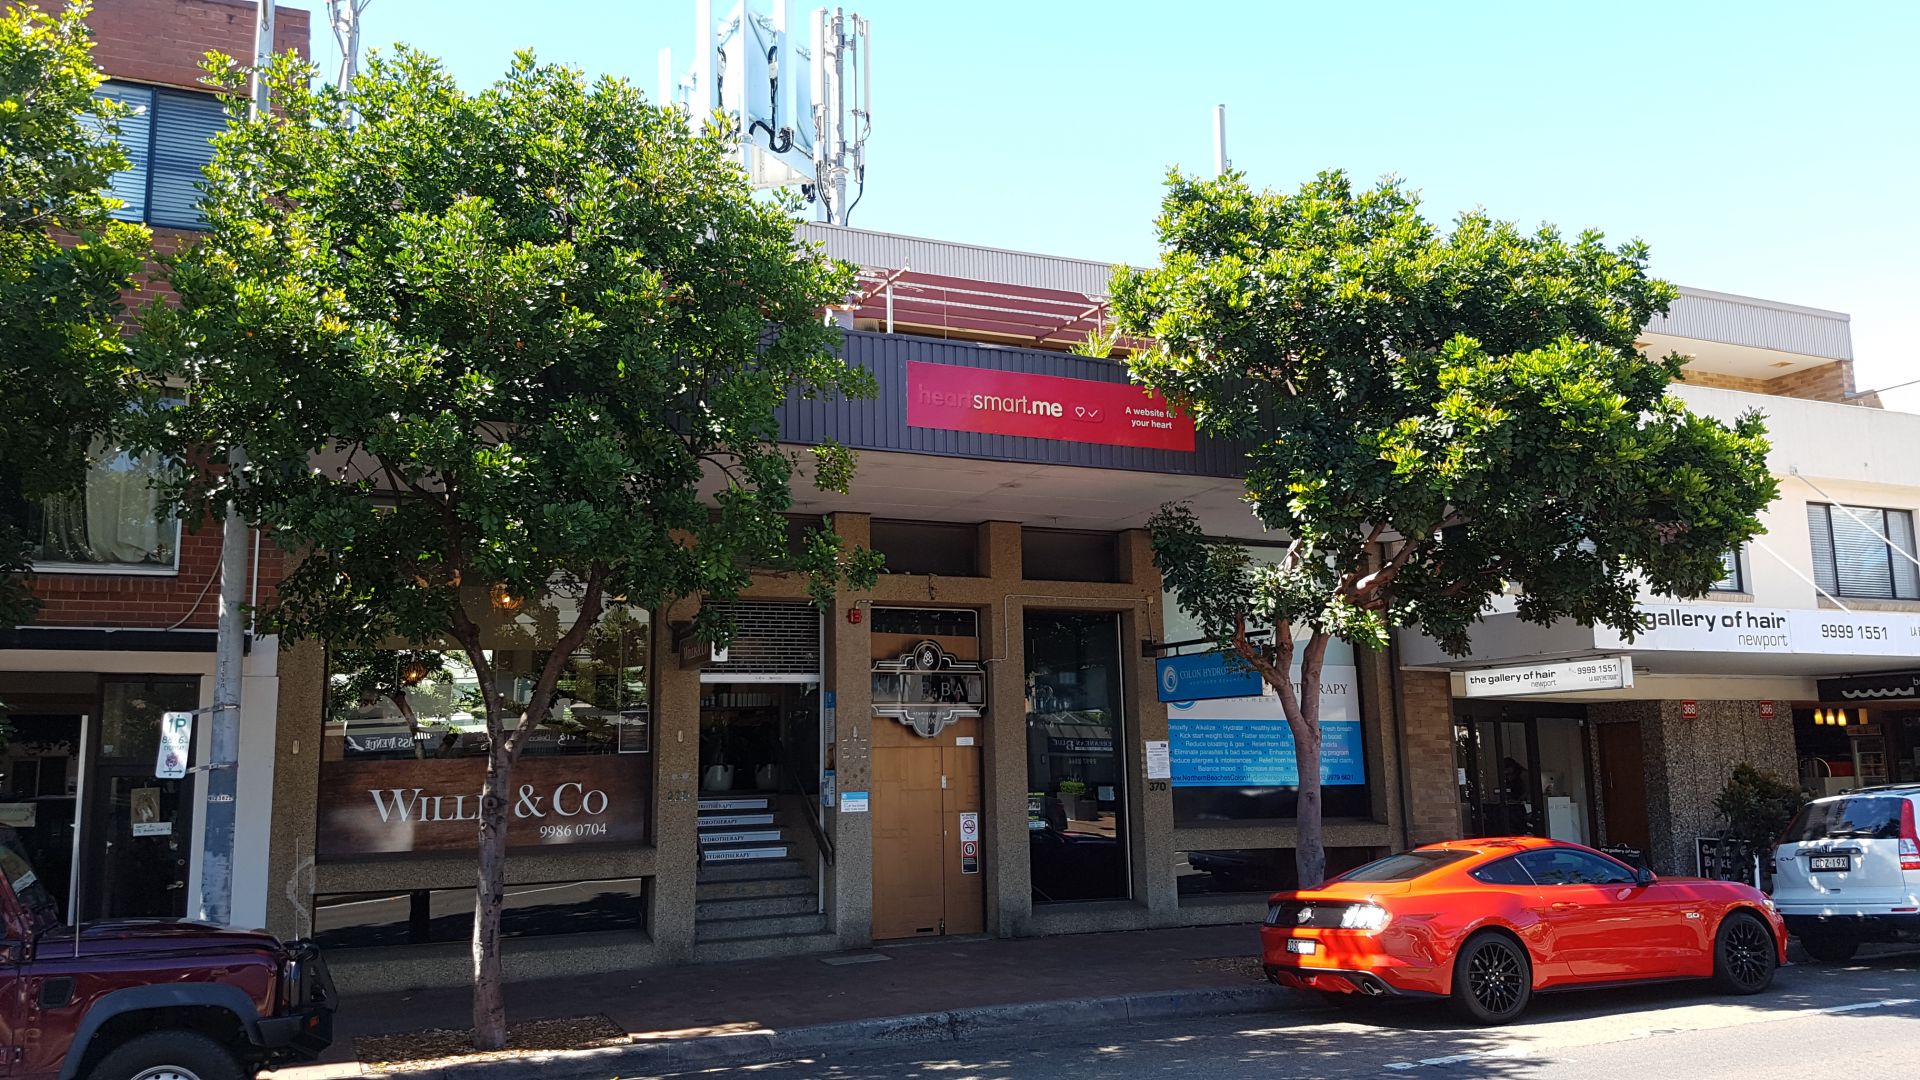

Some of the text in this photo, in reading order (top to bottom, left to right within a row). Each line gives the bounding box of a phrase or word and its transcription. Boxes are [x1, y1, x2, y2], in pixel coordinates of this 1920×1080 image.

[919, 384, 1063, 418] heartsmart.me
[1125, 406, 1132, 415] A
[1133, 408, 1164, 418] website
[1131, 419, 1173, 430] your heart
[1644, 608, 1785, 632] gallery of hair
[1821, 624, 1888, 640] 9999 1551
[1738, 633, 1788, 649] newport
[1179, 671, 1202, 680] COLON
[1577, 665, 1597, 675] 9999
[1598, 664, 1617, 673] 1551
[1470, 670, 1556, 685] the gallery of hair
[1531, 679, 1557, 688] newport
[1683, 704, 1696, 714] 368
[1761, 704, 1773, 714] 366
[169, 718, 187, 733] 1P
[1250, 725, 1269, 733] Healthy
[1149, 782, 1167, 792] 370
[367, 788, 484, 823] WILLI
[513, 783, 546, 818] &
[538, 822, 606, 839] 9986 0704
